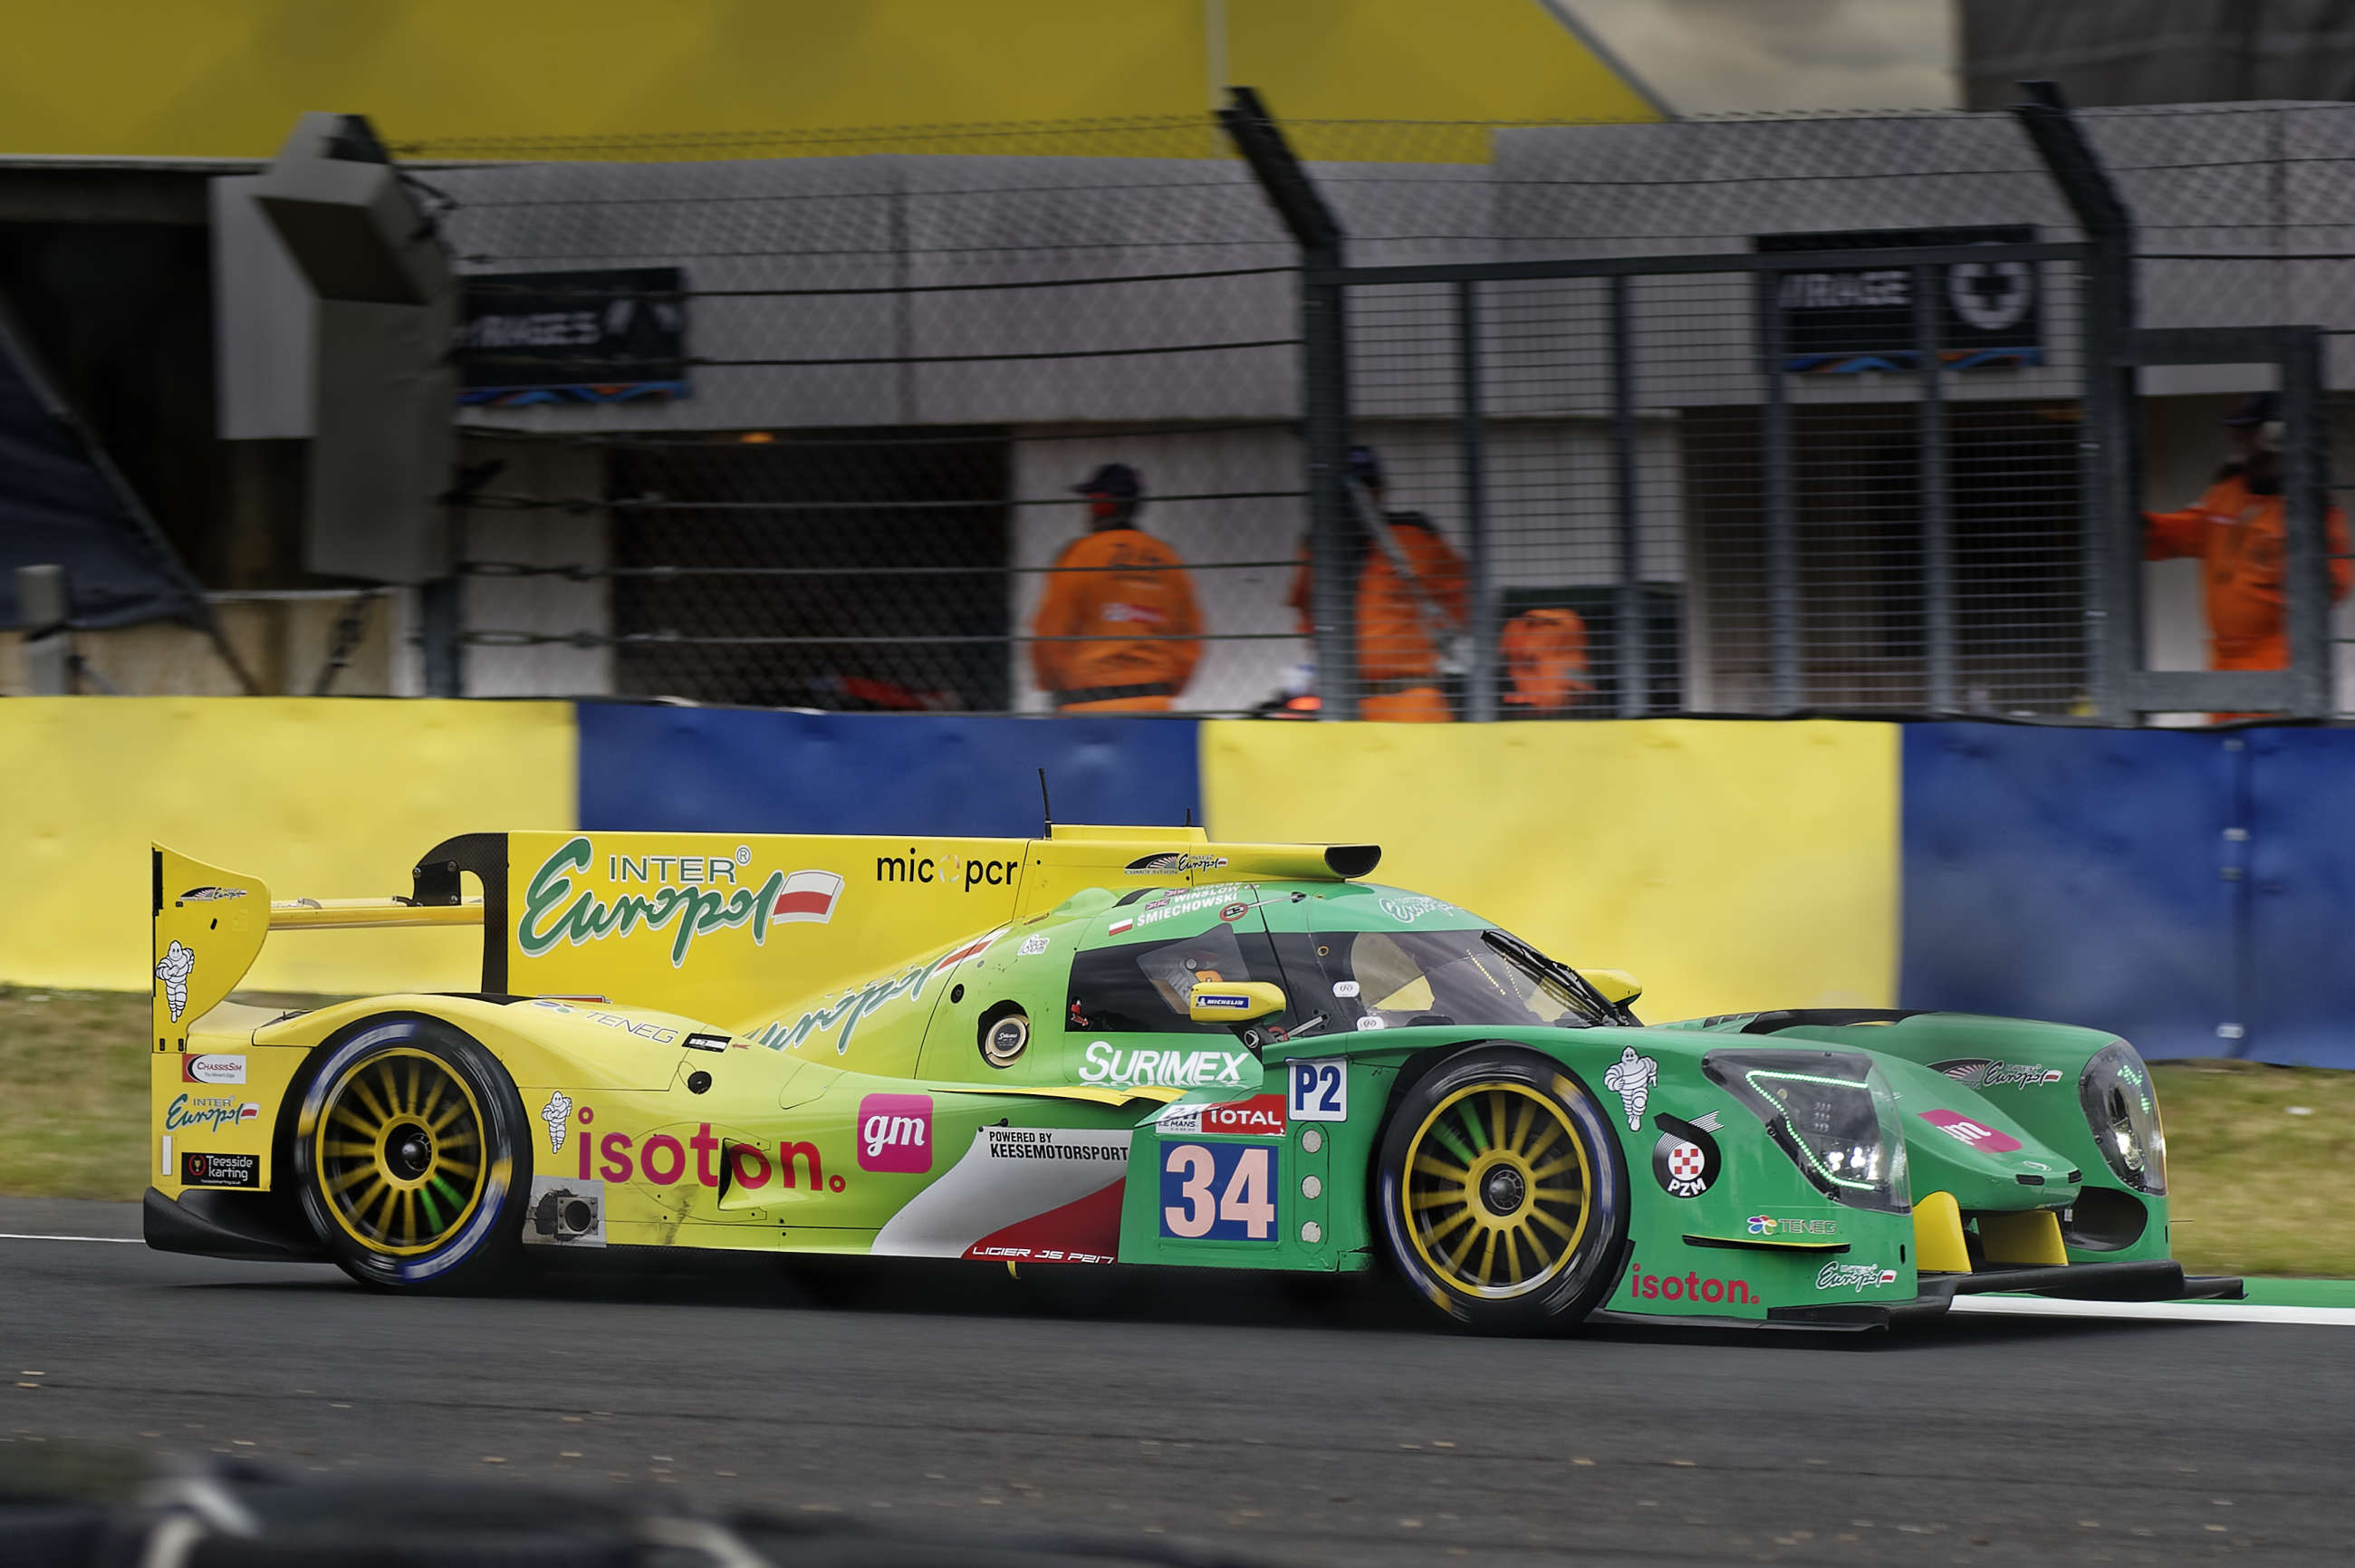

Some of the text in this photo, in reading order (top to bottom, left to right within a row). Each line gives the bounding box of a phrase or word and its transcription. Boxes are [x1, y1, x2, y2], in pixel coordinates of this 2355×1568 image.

[609, 854, 736, 885] INTER
[517, 835, 784, 969] Europol
[1174, 885, 1241, 903] WINSLOW
[750, 948, 958, 1056] uropol
[587, 1011, 678, 1044] TENEG
[1078, 1041, 1249, 1085] SURIMEX
[1984, 1059, 2047, 1090] Europol
[193, 1098, 232, 1107] INTER
[1295, 1064, 1343, 1112] P2
[166, 1093, 244, 1133] Europol
[1210, 1109, 1282, 1126] TOTAL
[577, 1106, 847, 1194] isoton.
[864, 1115, 926, 1157] gm
[989, 1131, 1053, 1143] POWERED BY
[206, 1155, 253, 1168] Teesside
[990, 1143, 1129, 1161] KEESEMOTORSPORT
[208, 1168, 248, 1181] karting
[1668, 1178, 1707, 1196] PZM
[1164, 1144, 1275, 1239] 34
[1778, 1218, 1838, 1235] TENEG
[972, 1246, 1115, 1264] LIGIER JS P217
[1631, 1264, 1760, 1305] isoton.
[1816, 1261, 1884, 1293] Europol
